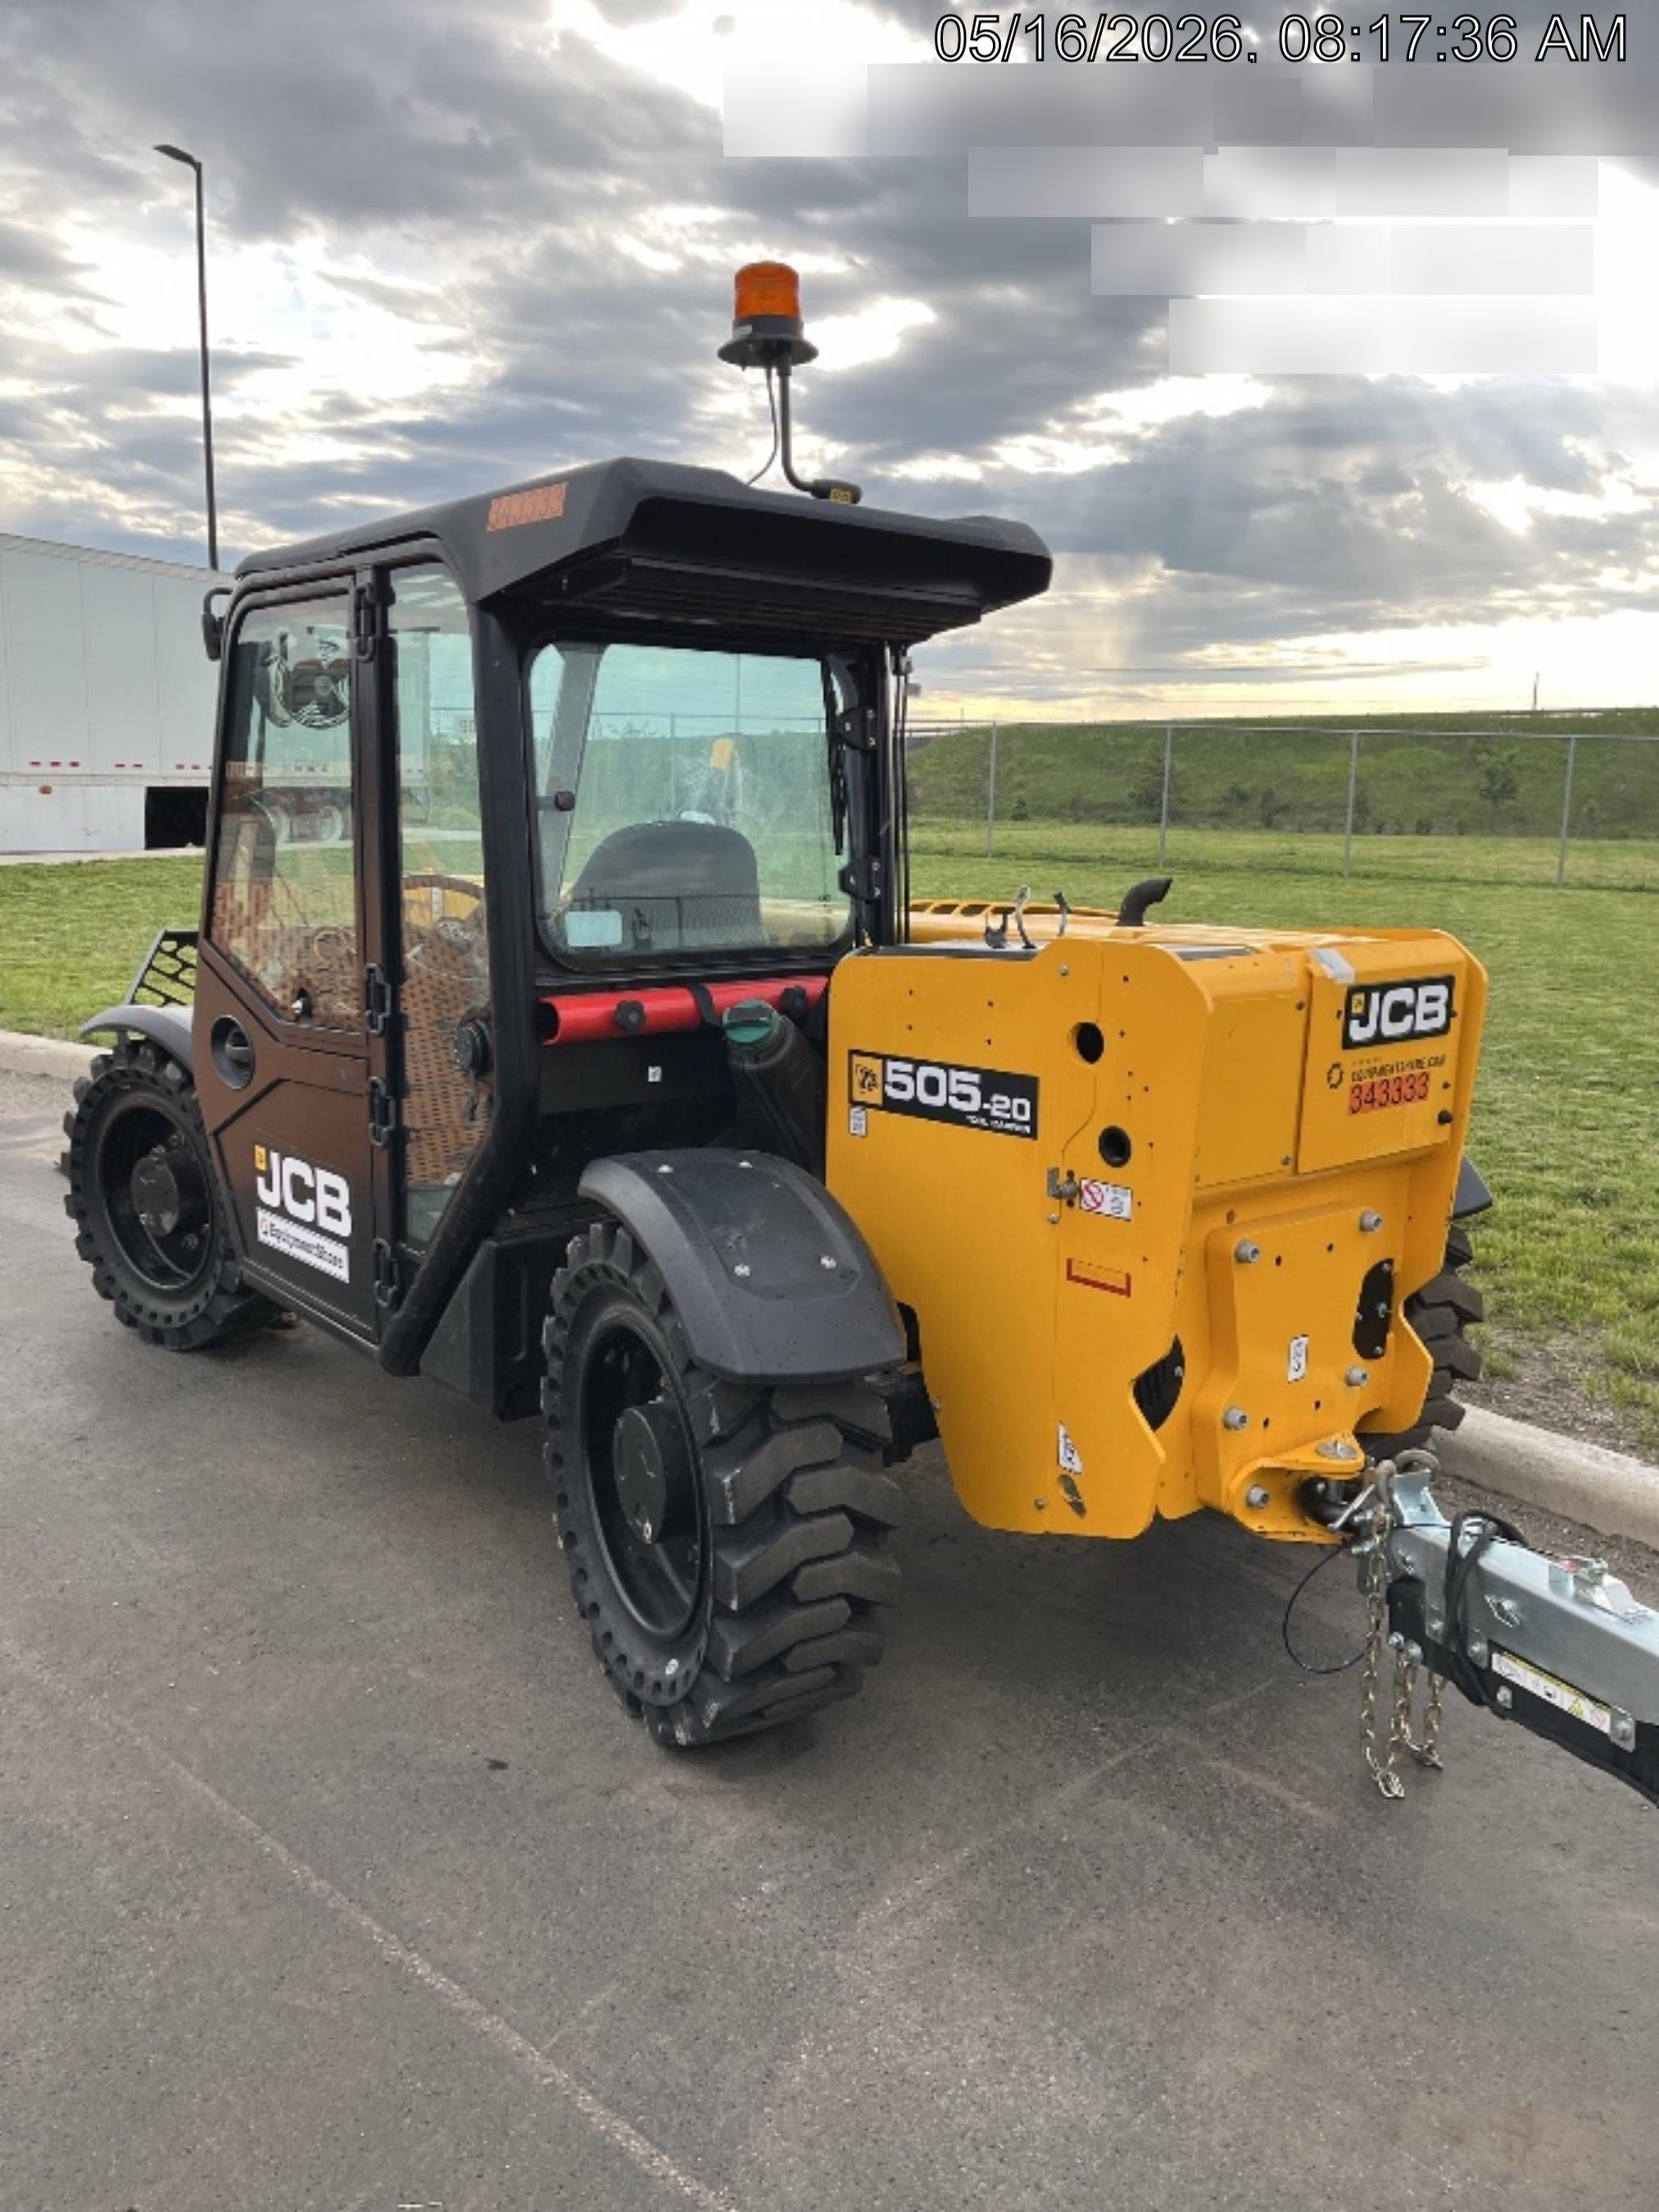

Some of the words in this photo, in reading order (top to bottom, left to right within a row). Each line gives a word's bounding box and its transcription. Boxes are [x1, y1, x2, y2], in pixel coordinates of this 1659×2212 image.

[1349, 983, 1449, 1042] JCB
[1350, 1072, 1430, 1115] 343333
[256, 1149, 352, 1237] JCB
